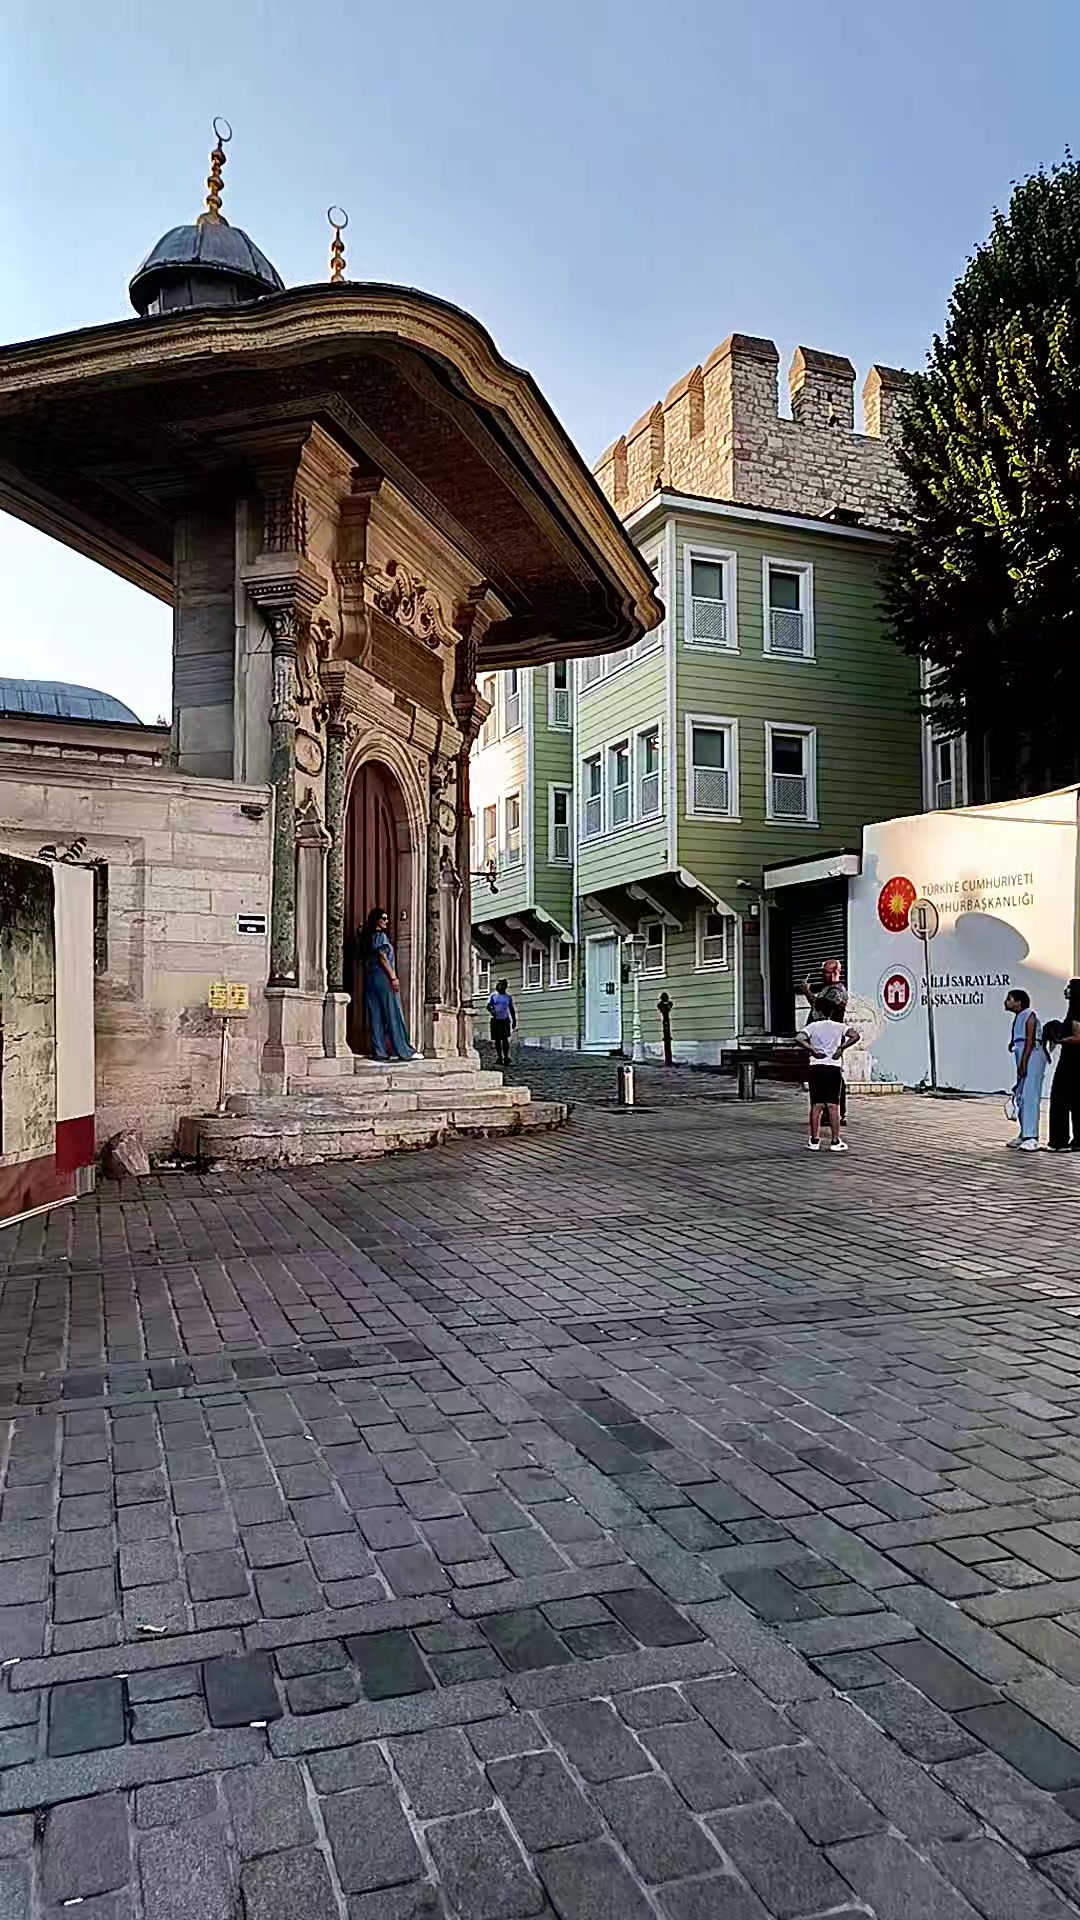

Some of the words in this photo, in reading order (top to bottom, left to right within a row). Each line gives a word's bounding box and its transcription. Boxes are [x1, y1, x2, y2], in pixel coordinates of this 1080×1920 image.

[922, 880, 960, 896] TÜRKİYE
[962, 872, 1033, 891] CUMHURİYETİ
[936, 892, 1034, 913] MHURBAŞKANLIĞI
[951, 974, 1010, 987] SARAYLAR
[921, 991, 984, 1007] BAŞKANLIĞI
